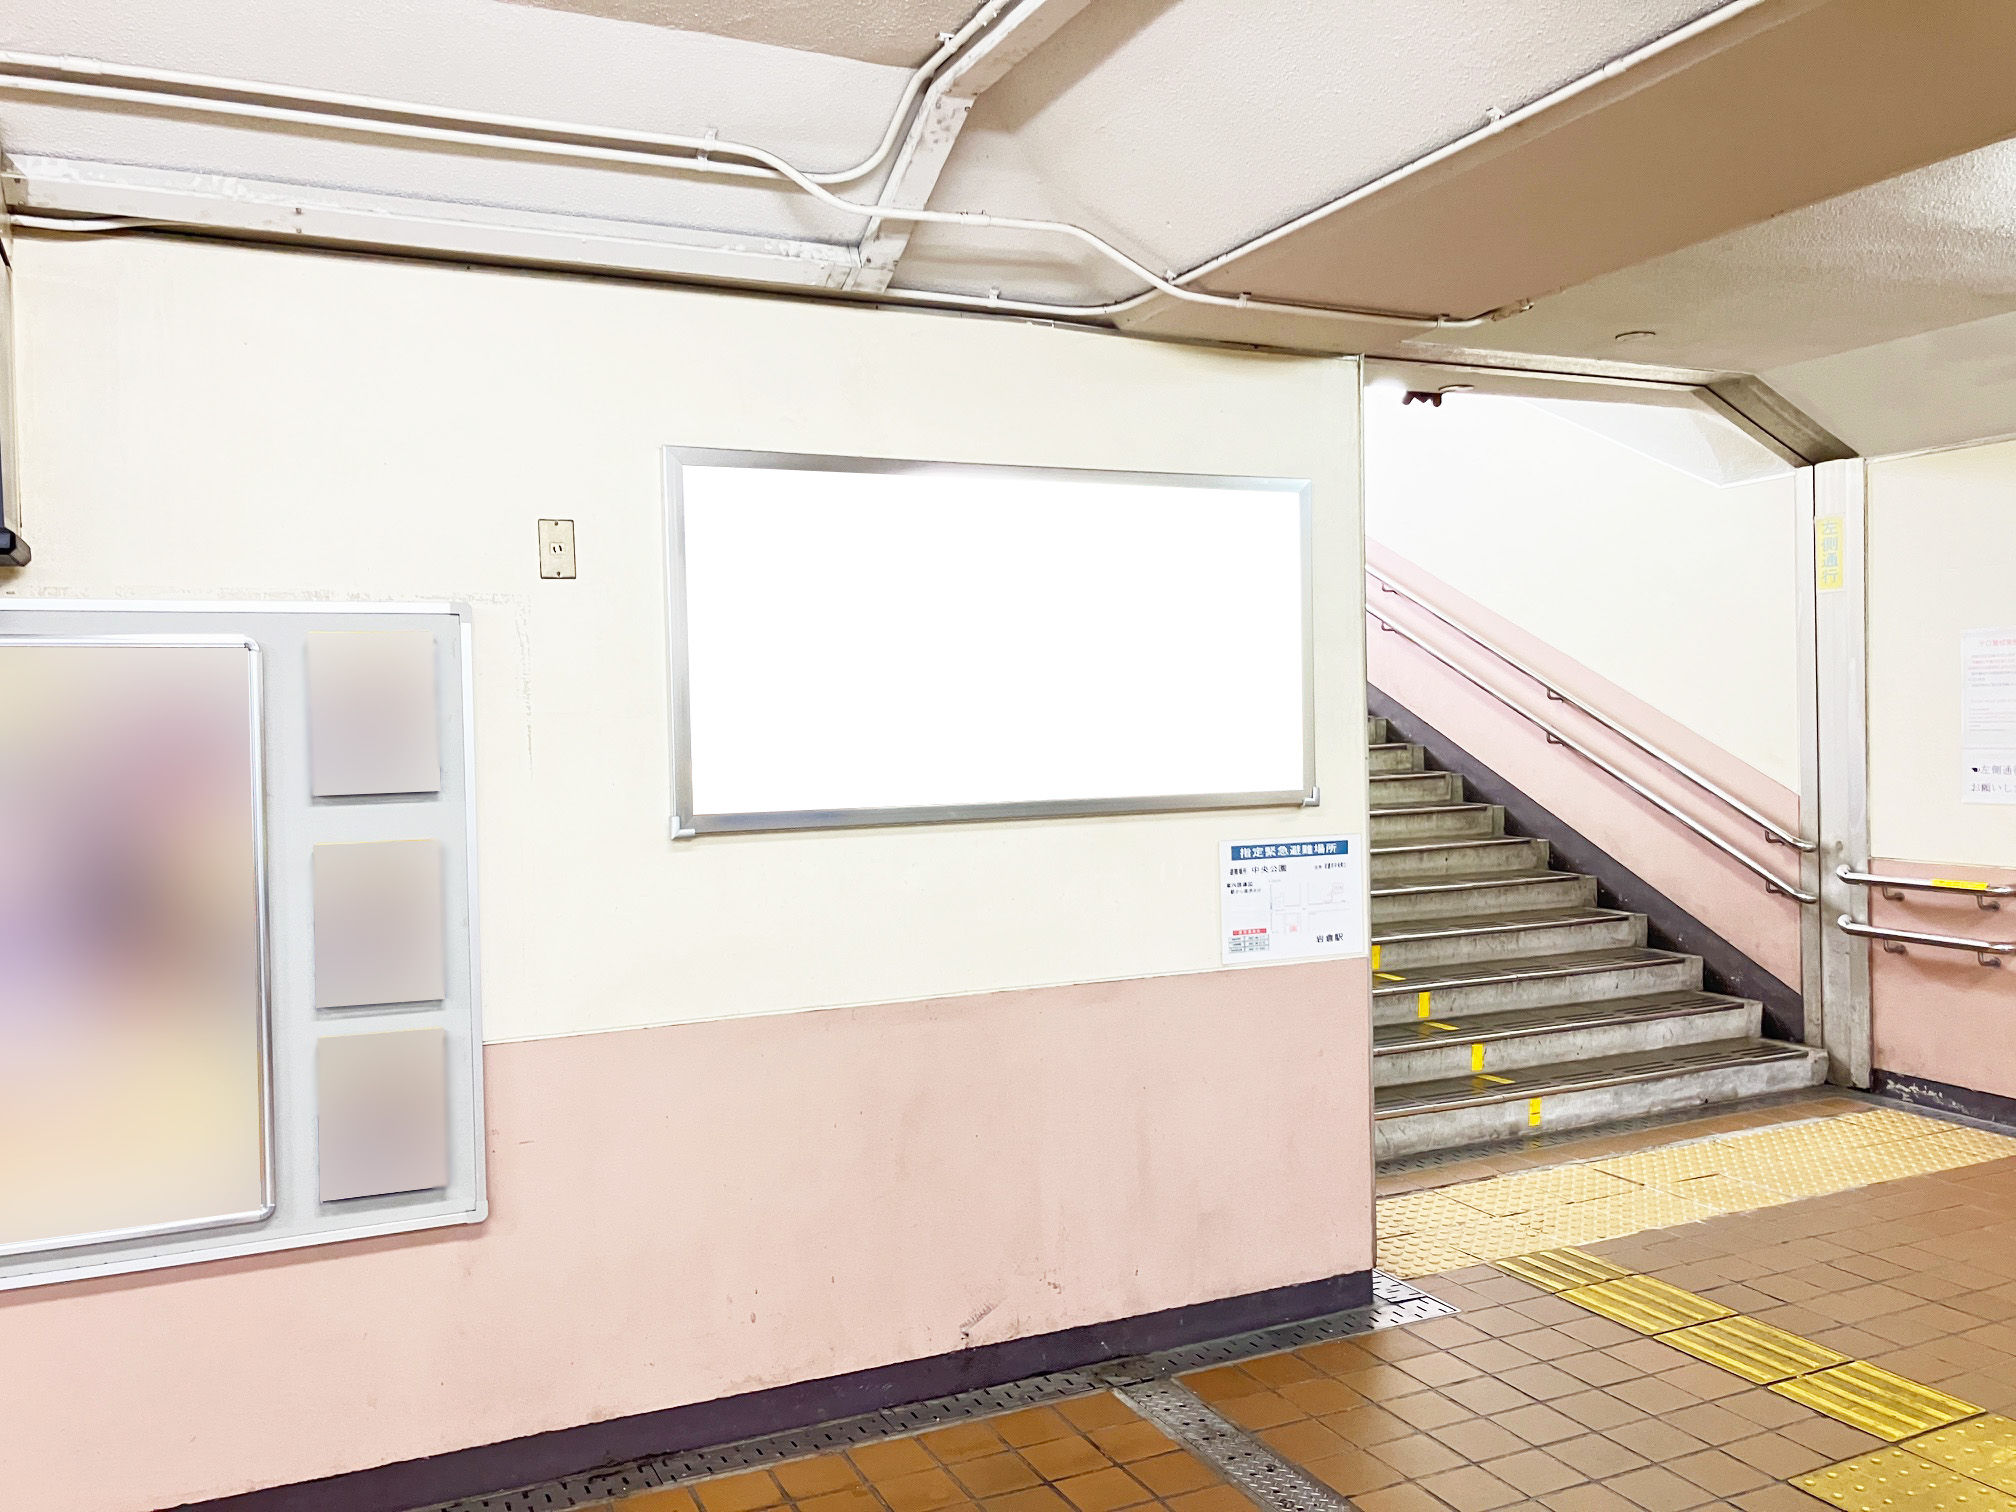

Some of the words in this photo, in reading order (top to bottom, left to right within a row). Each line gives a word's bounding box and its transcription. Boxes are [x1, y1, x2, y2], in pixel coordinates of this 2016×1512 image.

[1821, 521, 1839, 584] 左側通行
[1981, 764, 2016, 776] 左側通
[1239, 843, 1337, 859] 指定緊急避難場所
[1251, 864, 1287, 874] 中央公園
[1316, 932, 1344, 944] 岩倉駅
